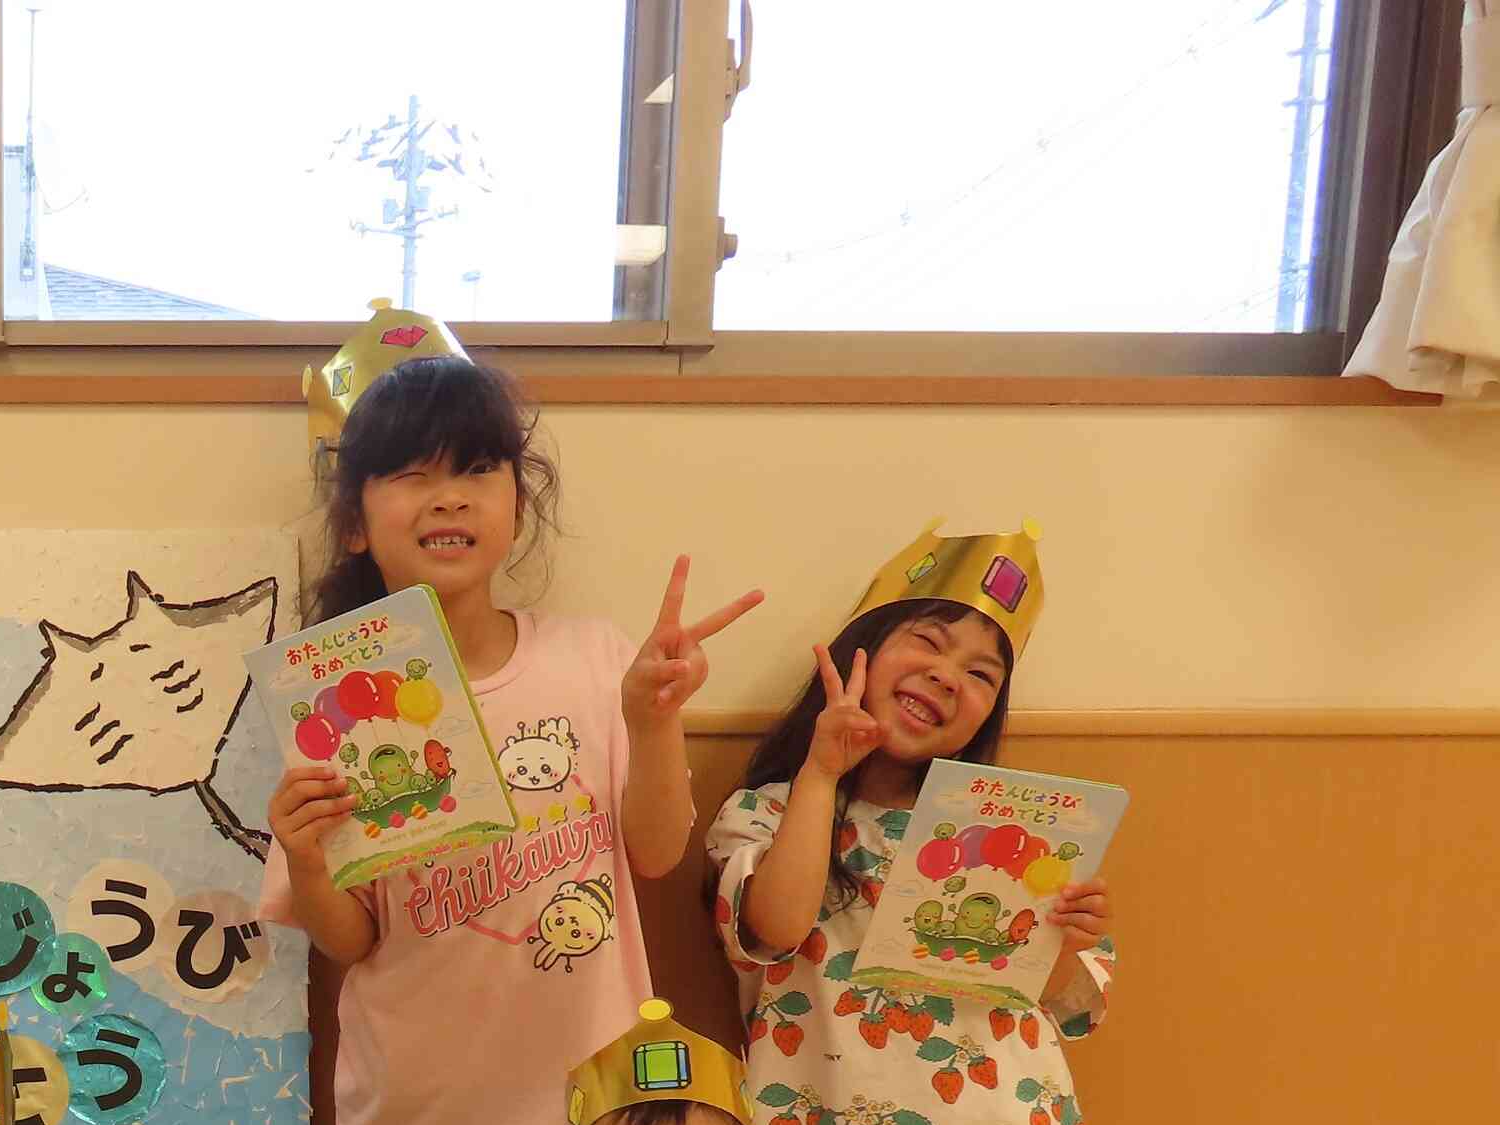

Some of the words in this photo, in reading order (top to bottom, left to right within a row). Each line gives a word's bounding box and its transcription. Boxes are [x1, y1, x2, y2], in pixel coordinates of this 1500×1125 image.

[285, 616, 389, 666] おたんじょうび
[311, 640, 385, 681] おめでとう
[970, 778, 1082, 809] おたんじょうび
[980, 801, 1058, 826] おめでとう
